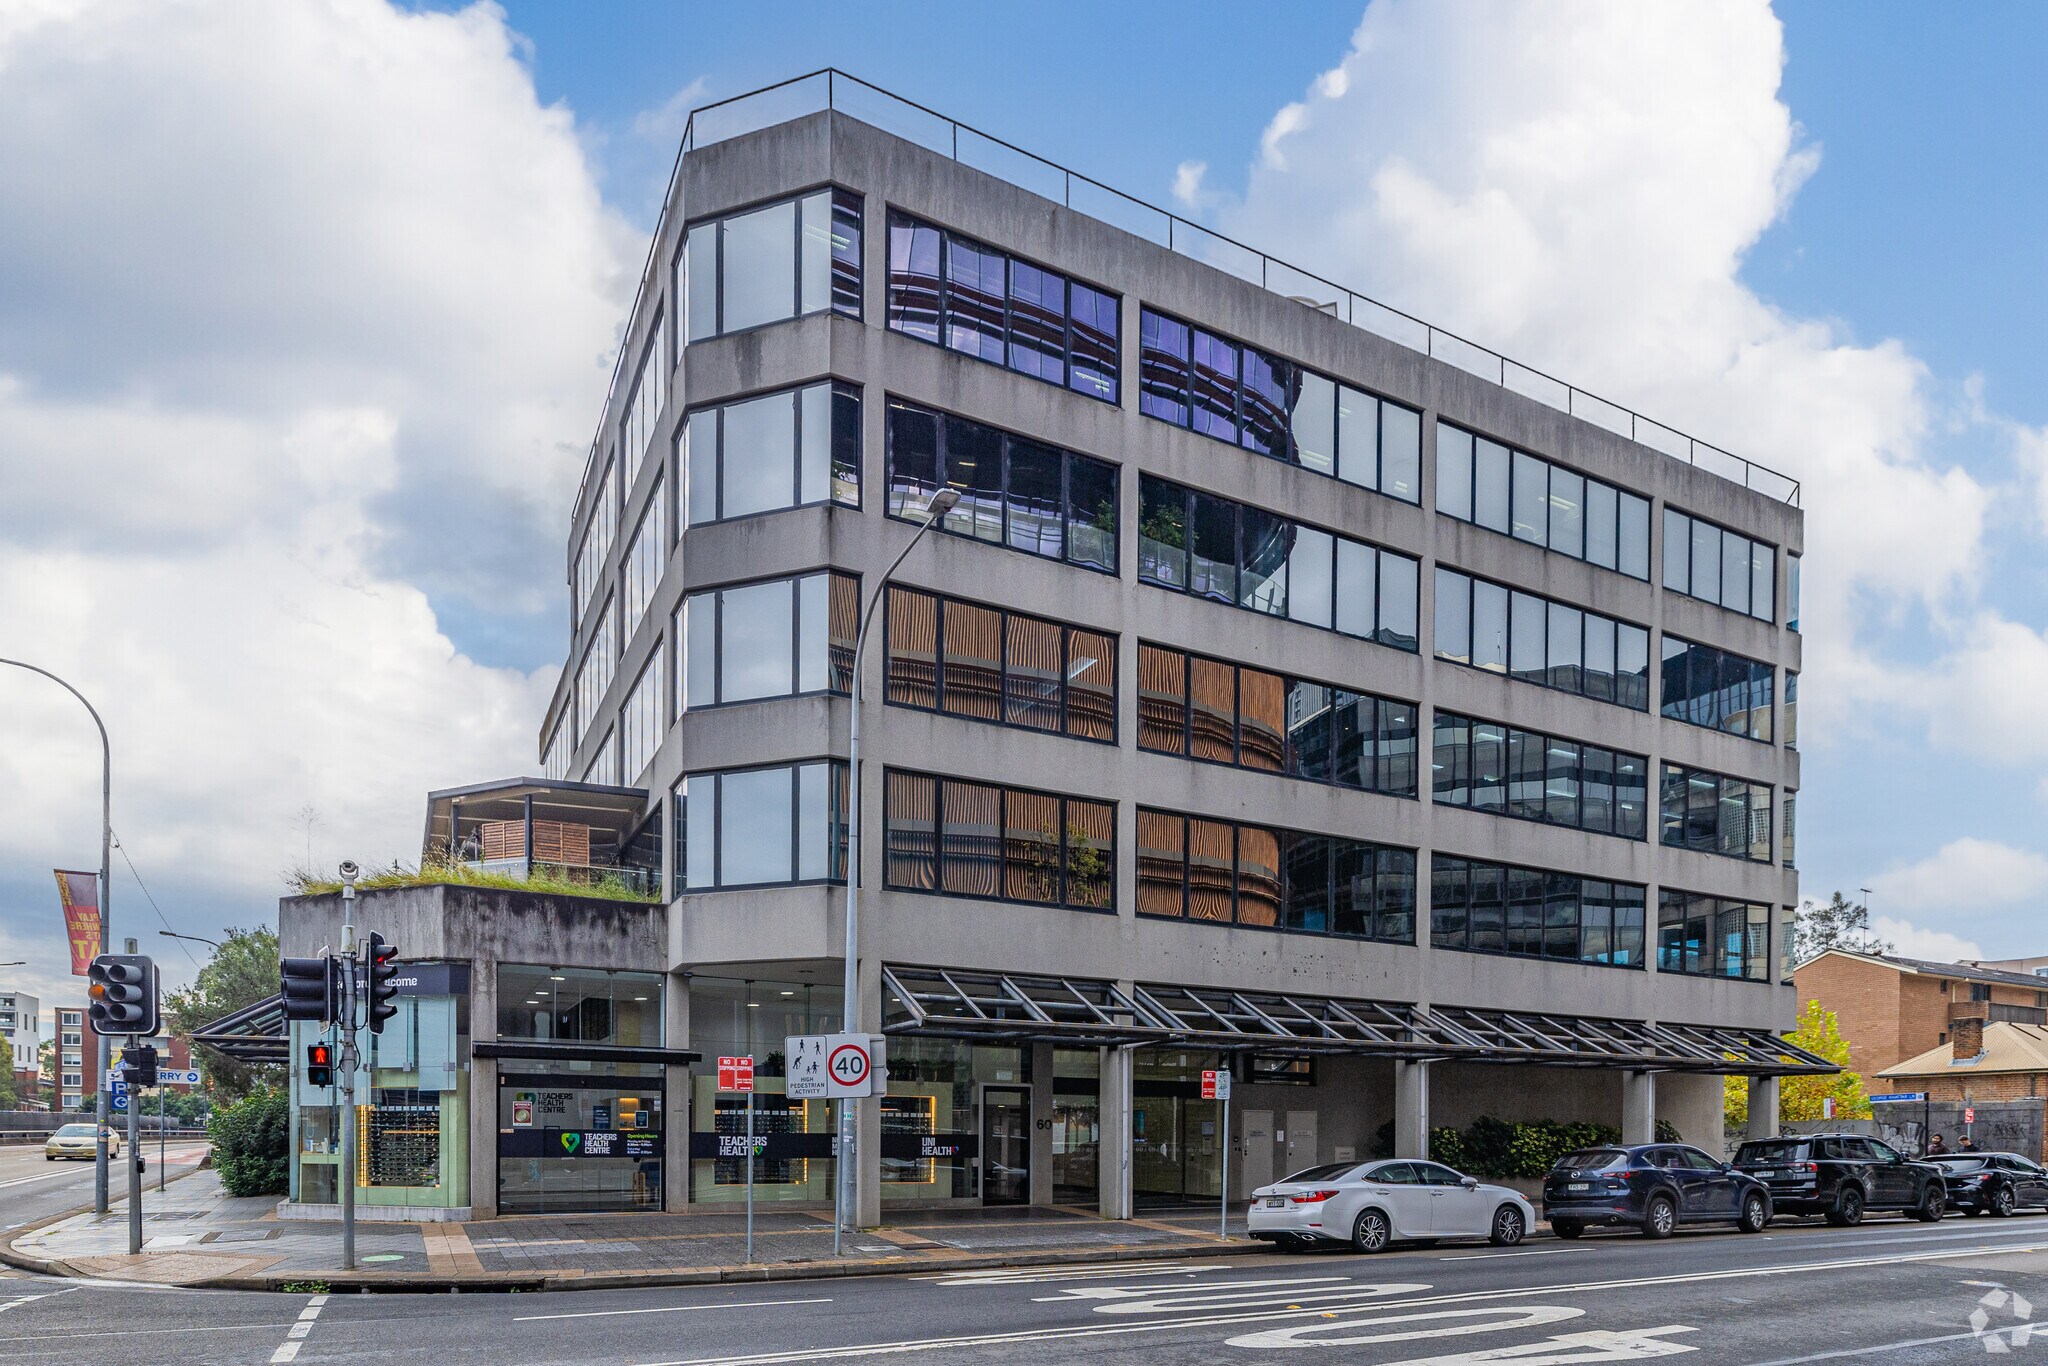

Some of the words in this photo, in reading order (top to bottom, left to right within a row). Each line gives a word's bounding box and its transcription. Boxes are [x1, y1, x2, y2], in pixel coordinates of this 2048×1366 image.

[384, 977, 417, 986] elcome
[835, 1056, 863, 1075] 40
[156, 1072, 182, 1080] ERRY
[115, 1082, 127, 1094] P
[537, 1092, 573, 1100] TEACHERS
[537, 1099, 564, 1107] HEALTH
[537, 1106, 566, 1114] CENTRE
[1036, 1119, 1052, 1130] 60
[584, 1133, 618, 1141] TEACHERS
[921, 1137, 936, 1147] UNI
[584, 1146, 611, 1154] CENTRE
[921, 1146, 952, 1156] HEALTH
